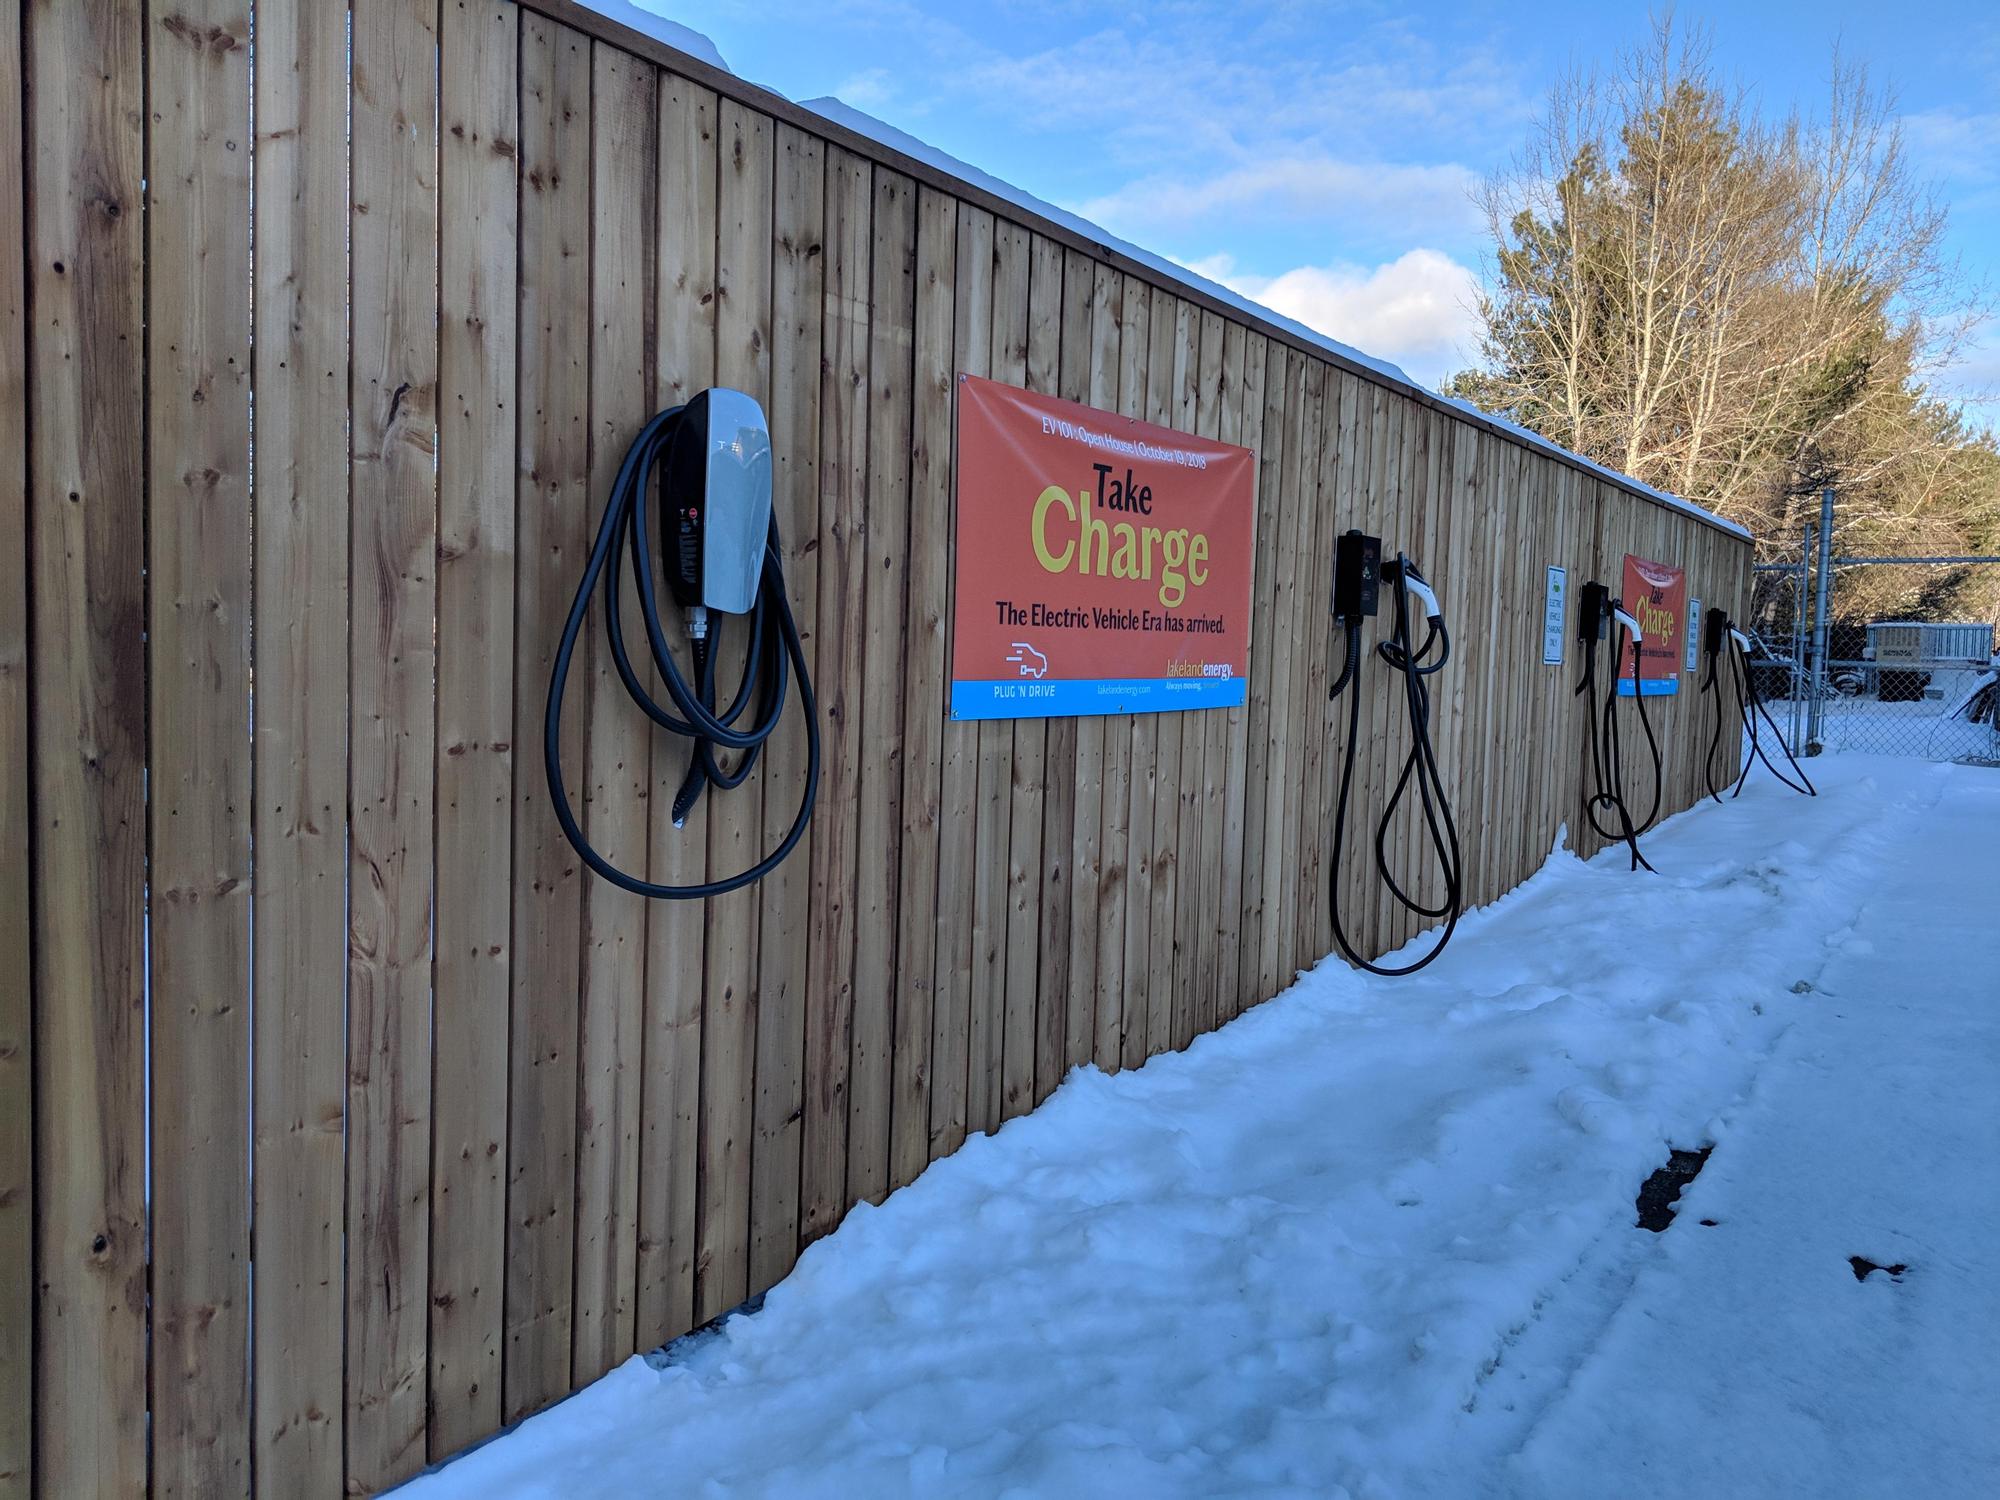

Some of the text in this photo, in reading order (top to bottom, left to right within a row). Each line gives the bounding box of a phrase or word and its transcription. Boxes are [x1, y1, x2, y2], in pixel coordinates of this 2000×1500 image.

[1042, 416, 1056, 435] EV
[1078, 426, 1104, 448] Open
[1105, 433, 1133, 454] House
[1138, 442, 1174, 461] October
[1187, 452, 1206, 470] 2018
[1093, 463, 1152, 515] Take
[1031, 485, 1209, 608] Charge
[996, 601, 1225, 634] The Electric Vehicle Era has arrived.
[1636, 595, 1674, 647] Charge
[994, 685, 1016, 698] PLUG
[1029, 685, 1056, 697] DRIVE
